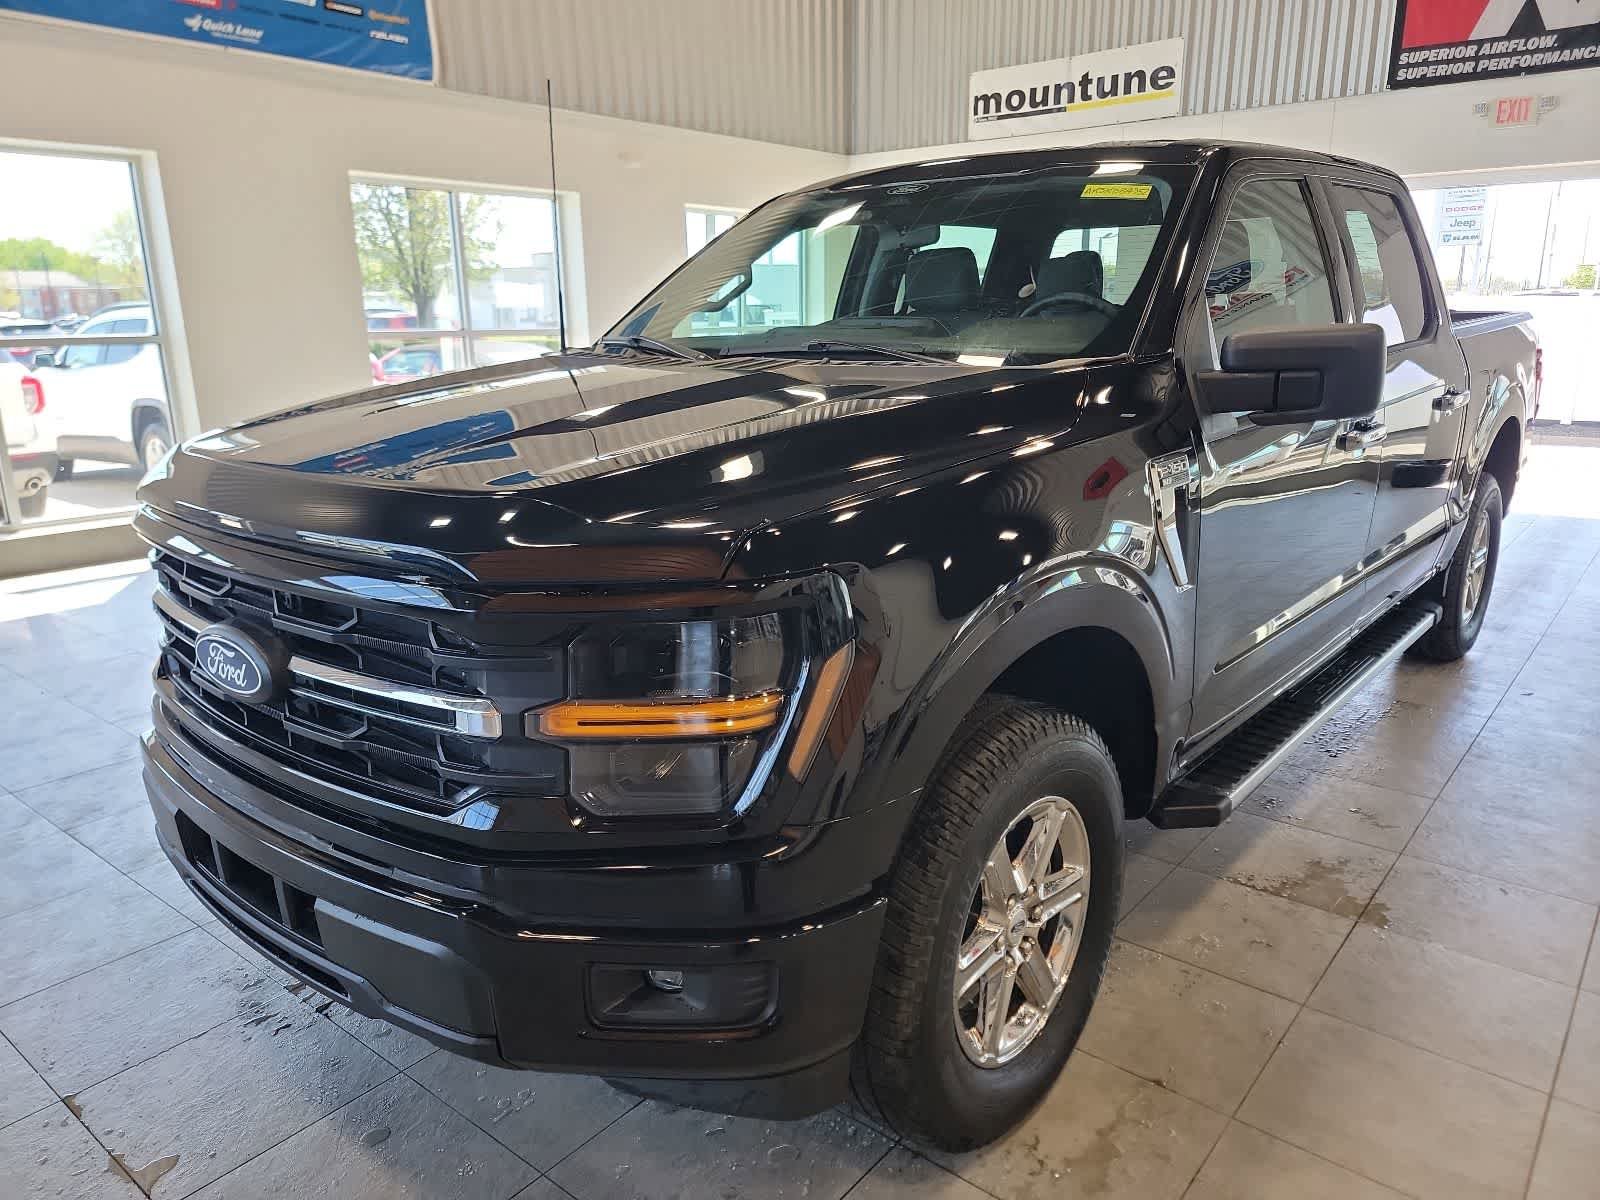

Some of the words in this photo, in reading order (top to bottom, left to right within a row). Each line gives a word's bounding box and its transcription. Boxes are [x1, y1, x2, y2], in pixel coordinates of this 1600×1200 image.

[202, 18, 236, 34] Quick
[236, 24, 264, 40] Lane
[1398, 47, 1479, 65] SUPERIOR
[1478, 34, 1559, 55] AIRFLOW.
[1396, 59, 1476, 81] SUPERIOR
[973, 64, 1177, 117] mountune
[1496, 97, 1534, 124] EXIT
[1450, 218, 1476, 228] Jeep
[207, 642, 247, 687] Ford
